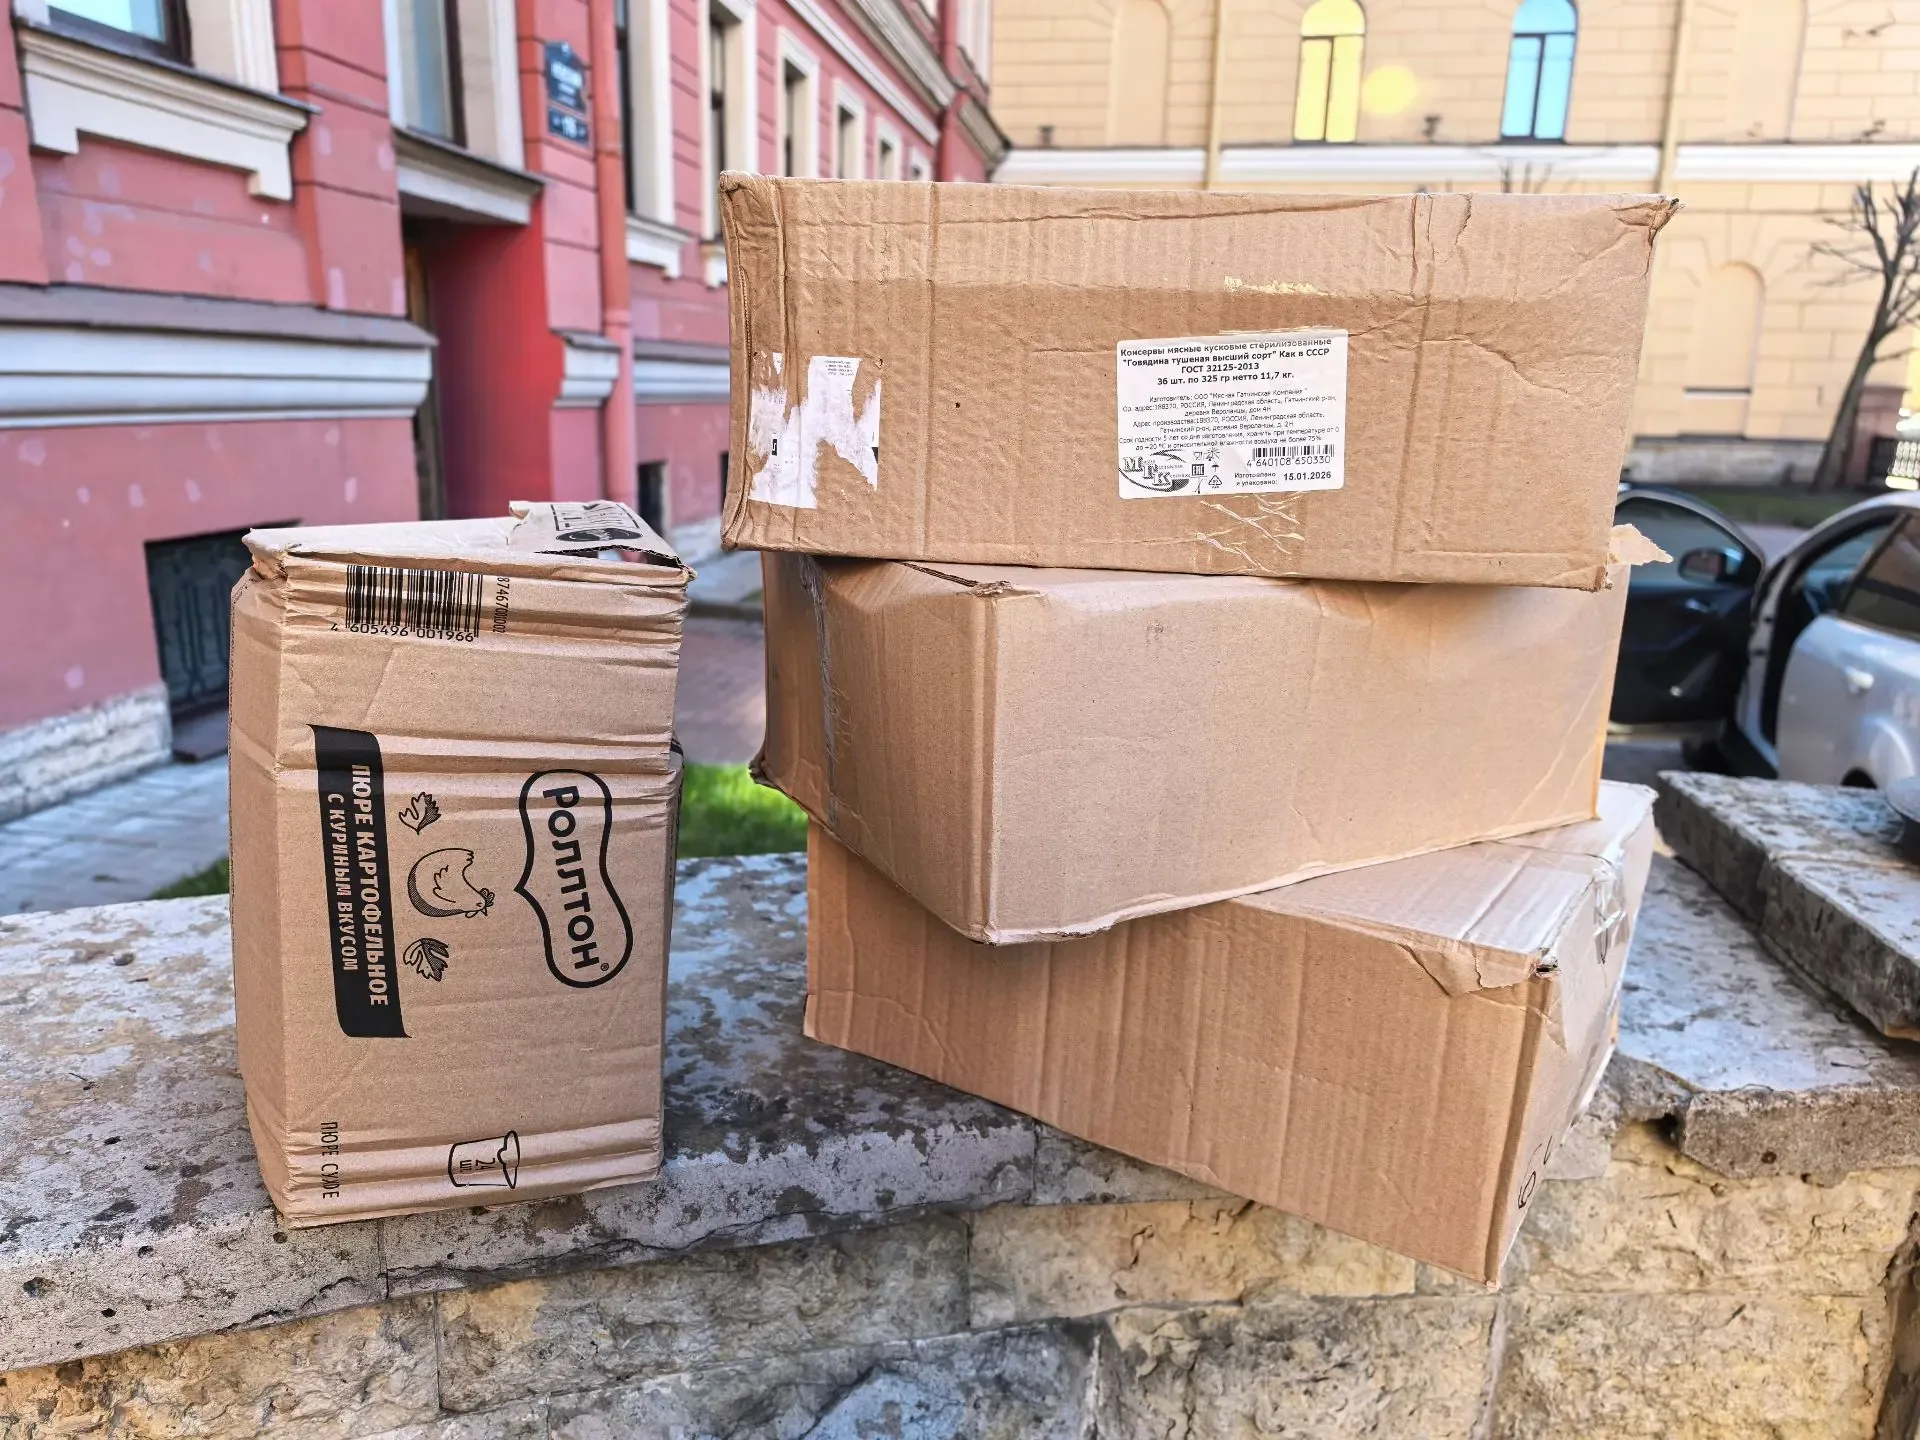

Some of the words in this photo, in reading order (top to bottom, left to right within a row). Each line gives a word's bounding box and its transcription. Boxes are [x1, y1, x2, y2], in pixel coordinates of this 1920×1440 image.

[1121, 349, 1164, 357] Консервы
[1168, 345, 1201, 353] мясные
[1204, 343, 1247, 353] кусковые
[1249, 339, 1332, 351] стерилизованные
[1172, 356, 1210, 365] тушеная
[1212, 352, 1249, 362] высший
[1252, 351, 1277, 361] сорт"
[1279, 350, 1296, 358] Как
[1306, 348, 1330, 357] СССР
[1181, 365, 1203, 373] ГОСТ
[1206, 363, 1260, 373] 32125-2013
[1157, 378, 1168, 386] 36
[1170, 377, 1186, 385] шт.
[1201, 375, 1218, 383] 325
[1260, 371, 1280, 380] 11,7
[1282, 371, 1295, 379] кг.
[1246, 459, 1252, 467] 4
[1255, 457, 1292, 467] 640108
[1294, 455, 1331, 465] 650330
[1241, 479, 1278, 487] упаковано:
[1283, 471, 1332, 481] 15.01.2026
[330, 623, 340, 632] 4
[350, 620, 409, 637] 605496
[416, 627, 474, 643] 001966
[327, 793, 338, 804] С
[351, 764, 374, 826] ПЮРЕ
[329, 808, 350, 897] КУРИНЫМ
[355, 831, 389, 1006] КАРТОФЕЛЬНОЕ
[337, 901, 358, 971] ВКУСОМ
[320, 1121, 339, 1157] ПЮРЕ
[475, 1157, 496, 1171] 24
